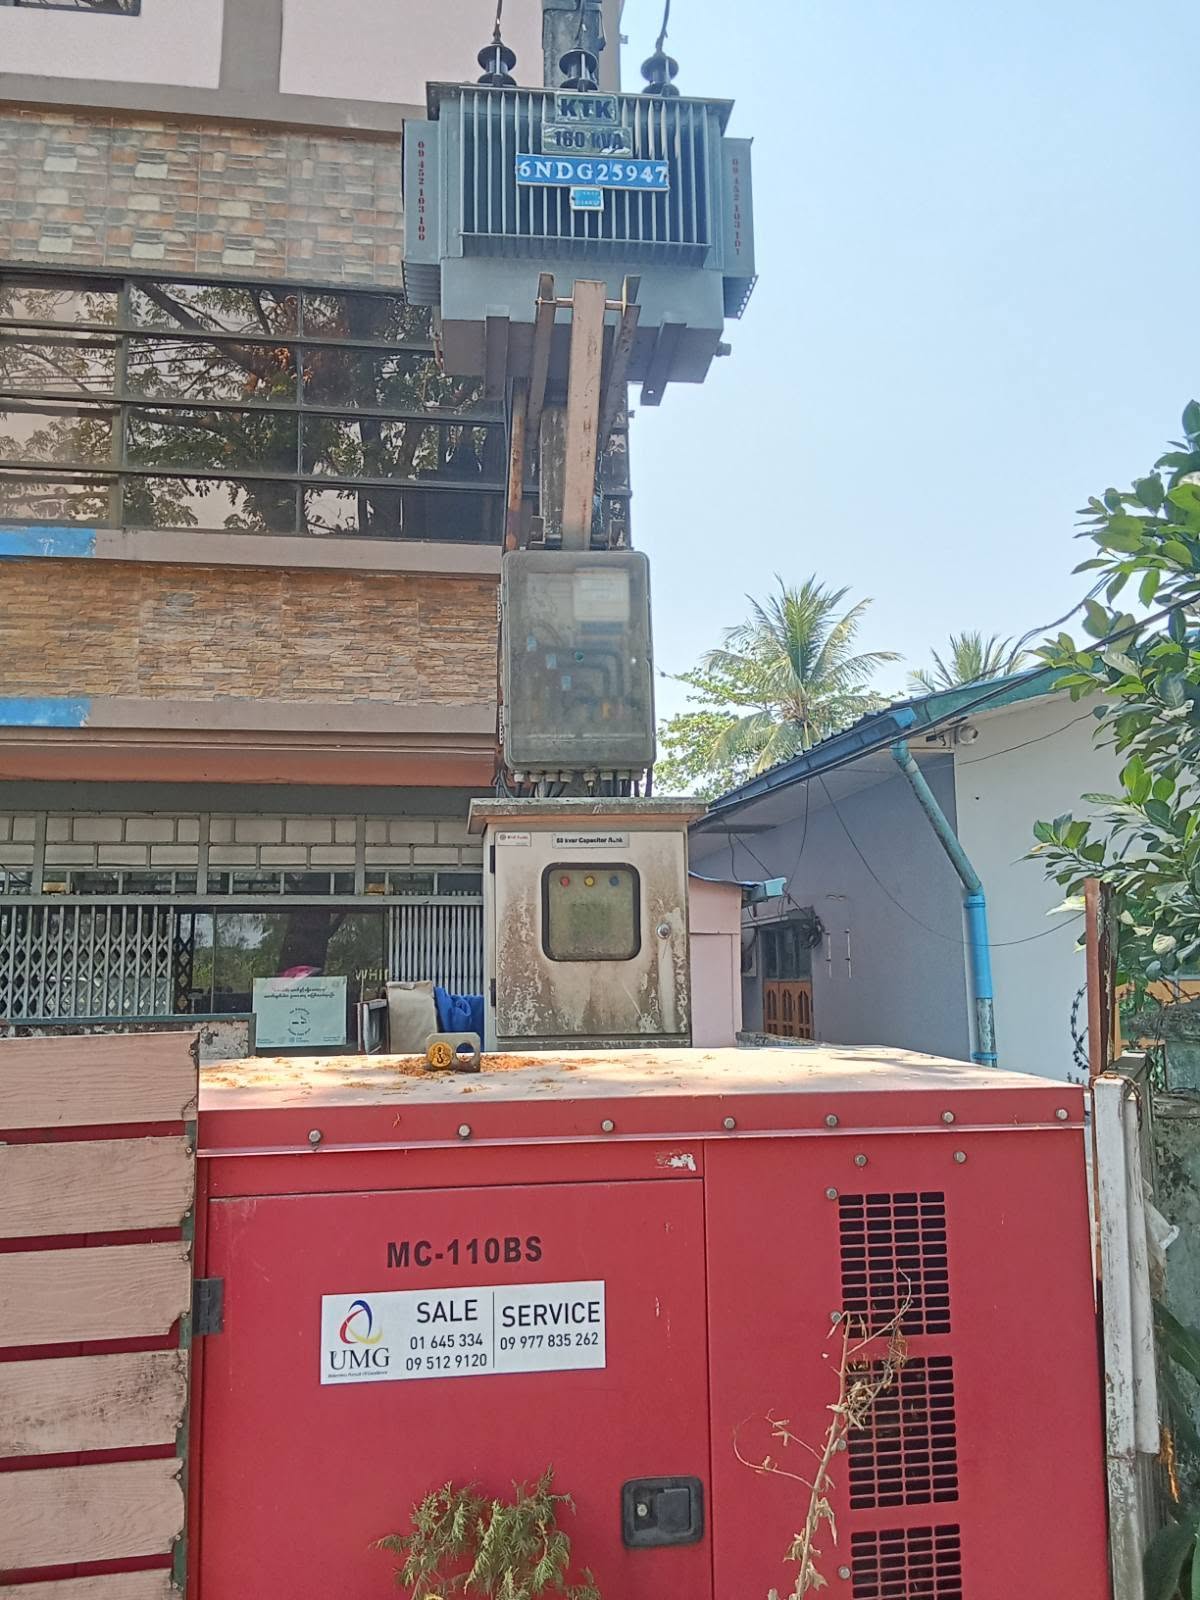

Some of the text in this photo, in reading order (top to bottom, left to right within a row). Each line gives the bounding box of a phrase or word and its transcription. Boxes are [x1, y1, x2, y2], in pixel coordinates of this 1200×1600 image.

[560, 98, 612, 119] KTK
[555, 130, 585, 148] 160
[519, 160, 668, 183] 6NDG25947
[387, 1236, 542, 1268] MC-110BS
[416, 1299, 478, 1324] SALE
[502, 1301, 600, 1328] SERVICE
[410, 1332, 484, 1350] 01 645 334
[500, 1331, 599, 1350] 09 977 835 262
[329, 1347, 391, 1370] UMG
[405, 1353, 488, 1371] 09 512 9120
